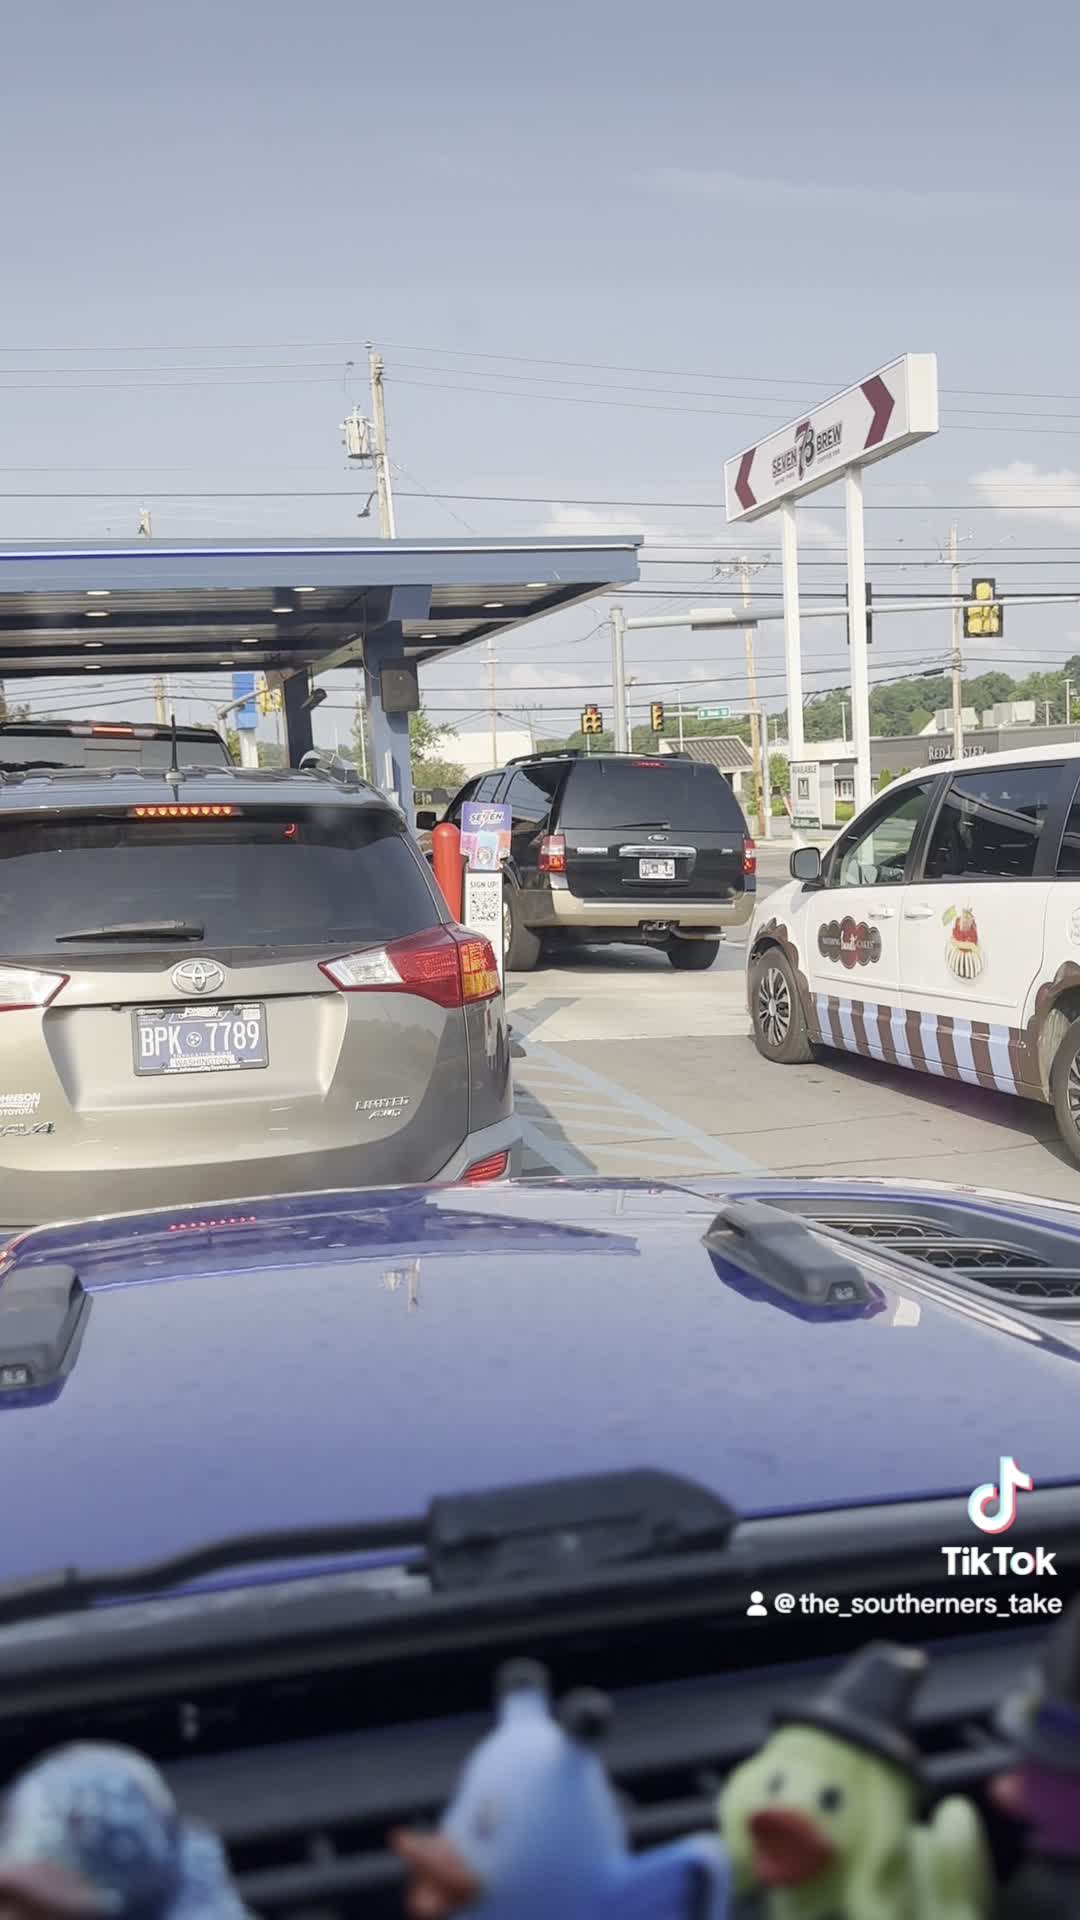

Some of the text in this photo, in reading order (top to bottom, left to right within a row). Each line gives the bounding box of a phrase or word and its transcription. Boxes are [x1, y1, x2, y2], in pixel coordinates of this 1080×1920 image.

[772, 446, 798, 477] SEVEN
[817, 423, 842, 454] BREW
[928, 745, 984, 760] RED LSTER
[470, 881, 486, 889] SIGN
[140, 1020, 260, 1056] BPK 7789
[174, 1055, 232, 1067] WASHINGTON
